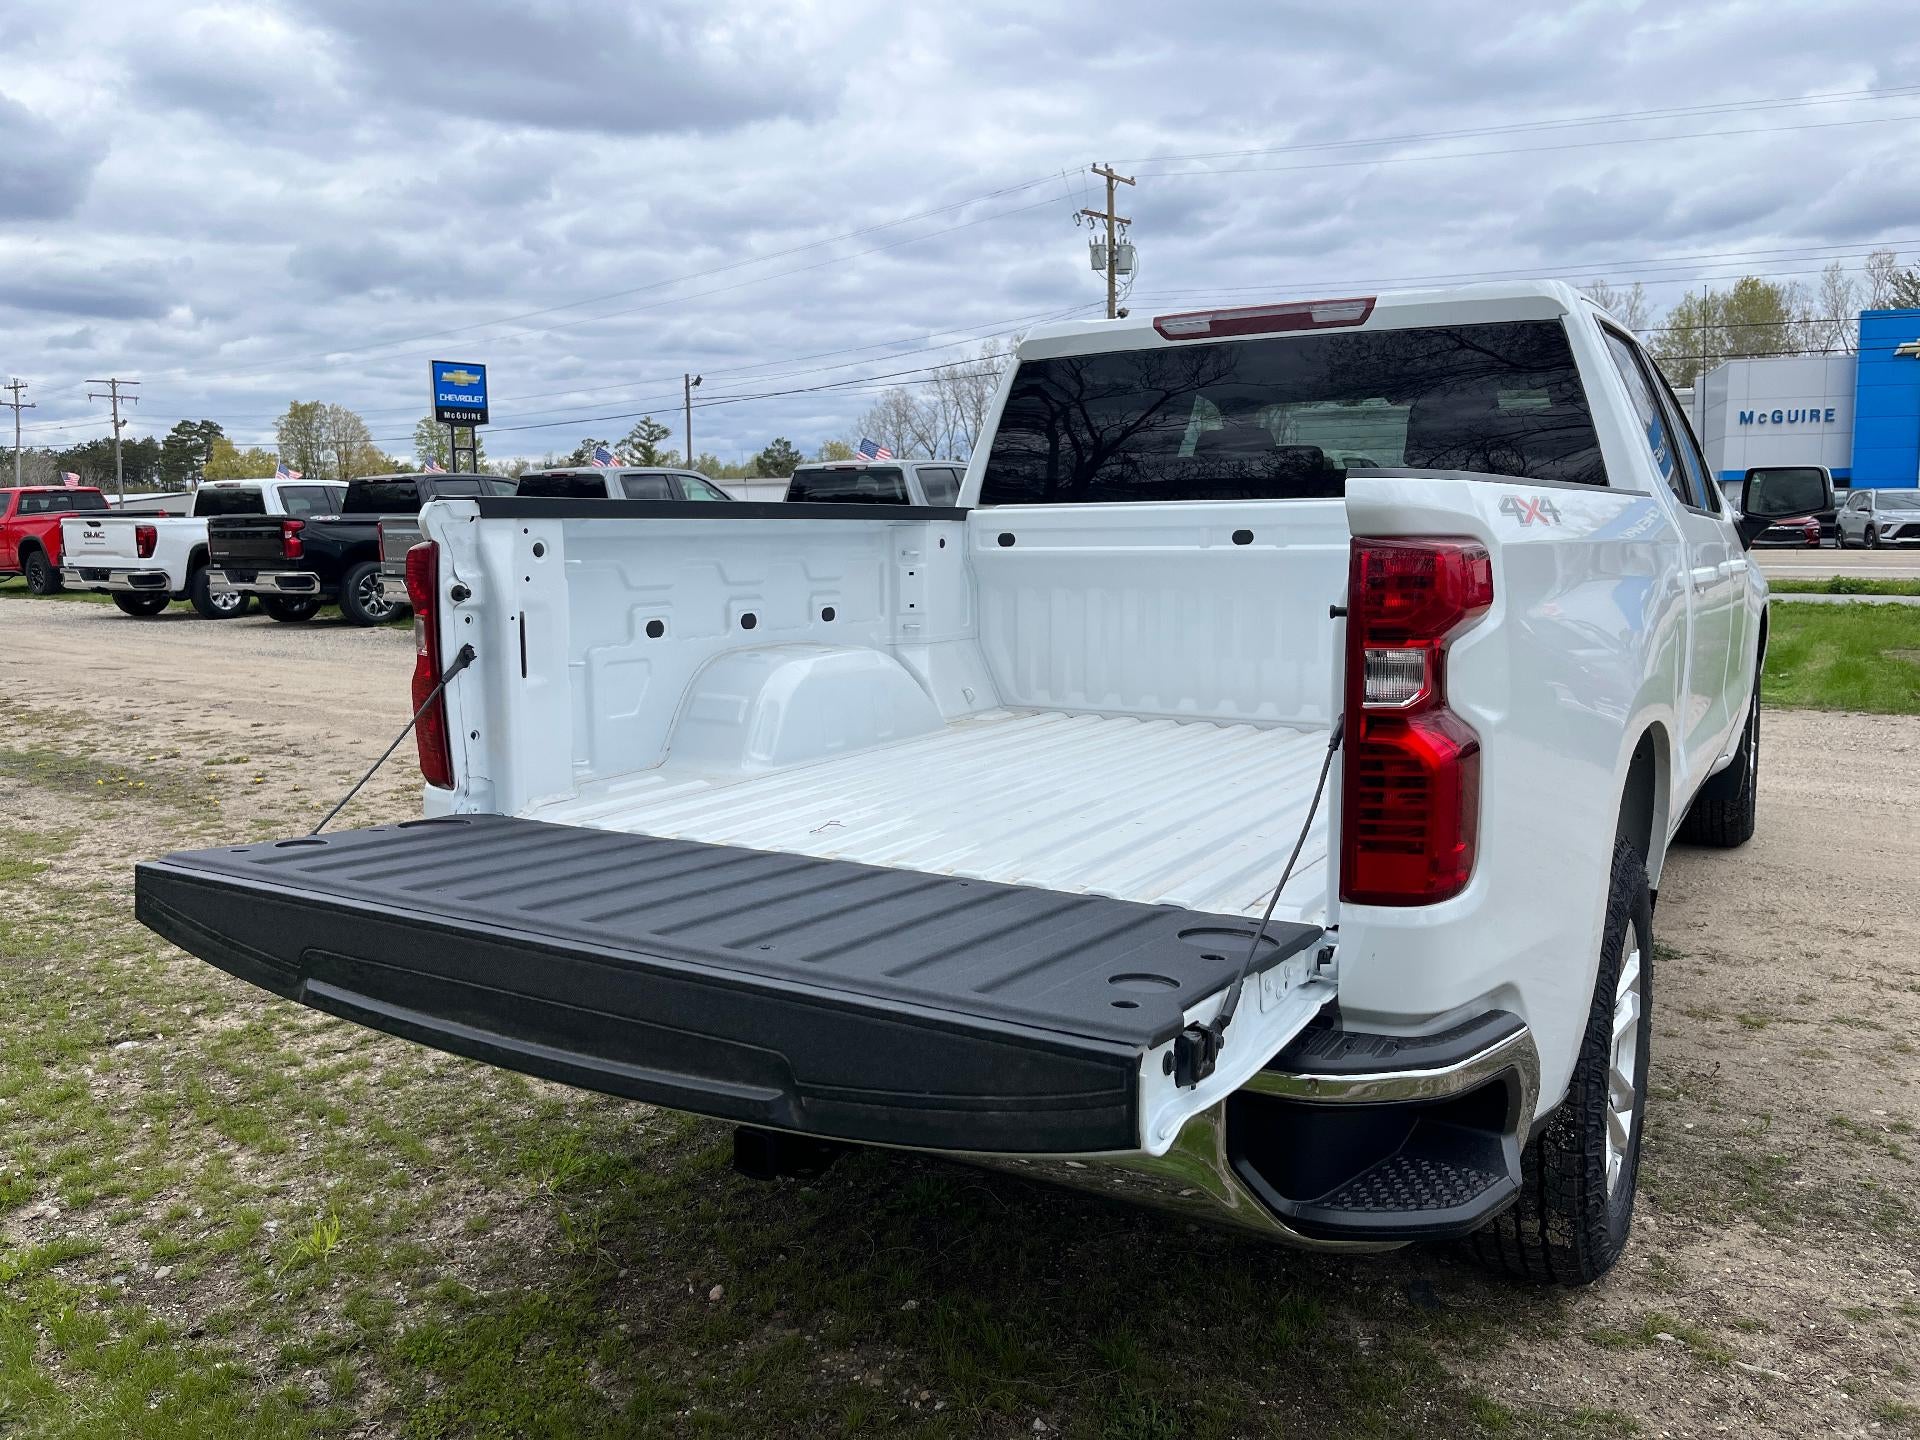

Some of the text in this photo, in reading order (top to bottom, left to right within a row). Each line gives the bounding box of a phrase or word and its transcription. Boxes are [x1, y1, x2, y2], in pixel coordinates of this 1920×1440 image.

[440, 393, 484, 403] CHEVROLET
[443, 411, 482, 421] McGUIRE
[1739, 408, 1836, 425] McGUIRE
[84, 531, 106, 539] GMC
